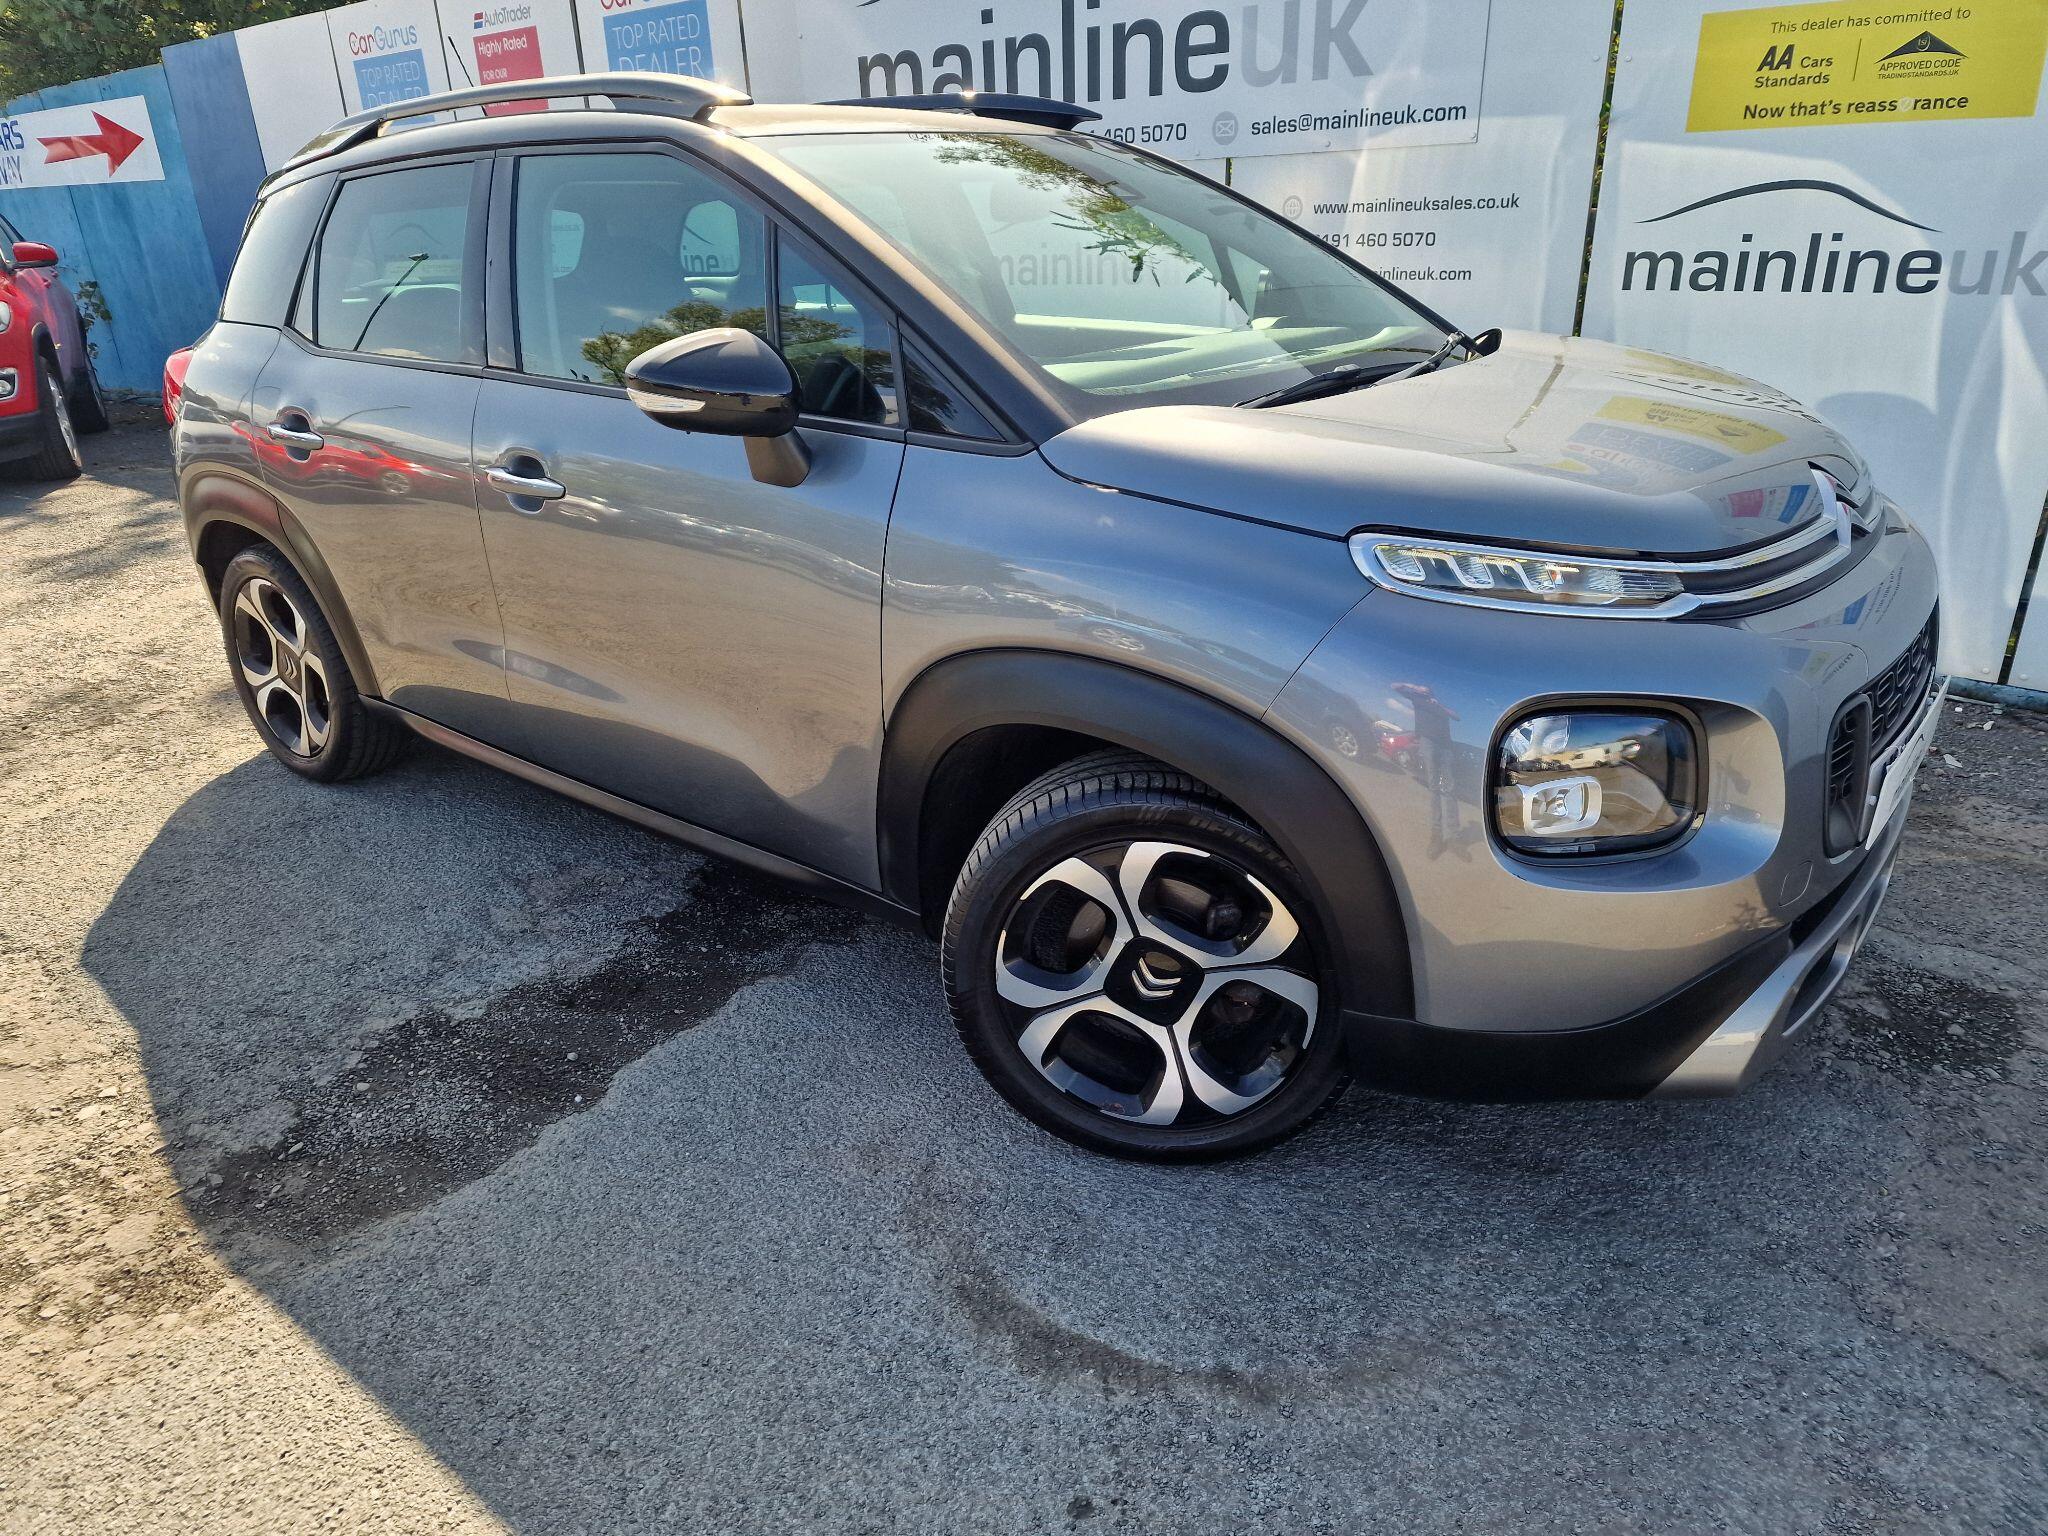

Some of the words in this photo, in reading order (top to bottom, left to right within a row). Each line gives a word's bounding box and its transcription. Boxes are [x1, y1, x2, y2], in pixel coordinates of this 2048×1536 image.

[484, 4, 531, 27] AutoTrader
[1771, 22, 1797, 34] This
[1801, 19, 1844, 32] dealer
[1847, 16, 1871, 28] has
[1875, 9, 1951, 26] committed
[1957, 8, 1971, 20] to
[348, 25, 418, 56] CarGurus
[612, 24, 643, 49] TOP
[648, 14, 700, 45] RATED
[478, 39, 502, 57] Highly
[503, 35, 527, 52] Rated
[857, 0, 1374, 104] mainlineuk
[1756, 44, 1795, 72] AA
[1800, 56, 1833, 69] Cars
[361, 66, 382, 88] TOP
[384, 60, 420, 85] RATED
[1879, 61, 1931, 73] APPROVED
[1933, 58, 1962, 69] CODE
[1754, 72, 1830, 88] Standards
[1251, 104, 1467, 135] sales@mainlineuk.com
[1743, 104, 1784, 120] Now
[1846, 96, 1969, 114] reassrance
[1142, 123, 1187, 142] 5070
[1313, 193, 1520, 214] www.mainlineuksales.co.uk
[1356, 233, 1387, 247] 460
[1392, 232, 1436, 247] 5070
[1621, 231, 2048, 296] mainlineuk
